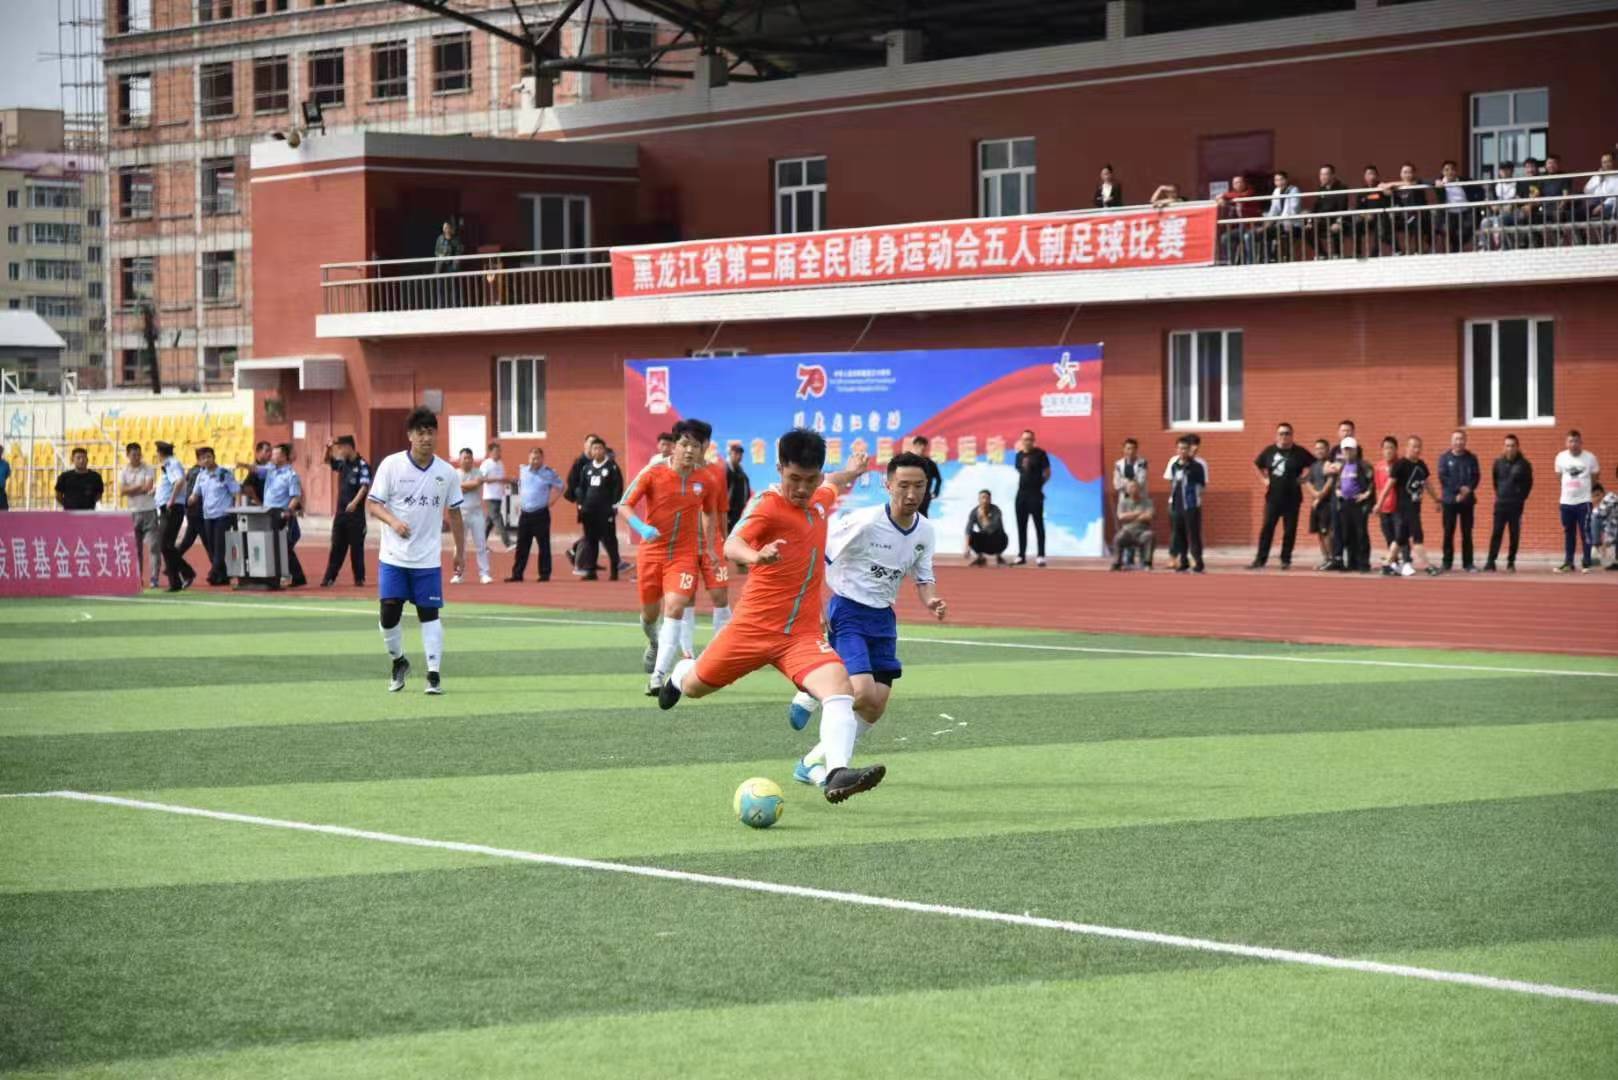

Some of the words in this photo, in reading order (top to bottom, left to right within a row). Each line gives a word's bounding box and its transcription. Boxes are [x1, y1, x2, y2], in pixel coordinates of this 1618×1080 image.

[633, 214, 1187, 291] 黑龙江省第三届全民健身运动会五人制足球比赛
